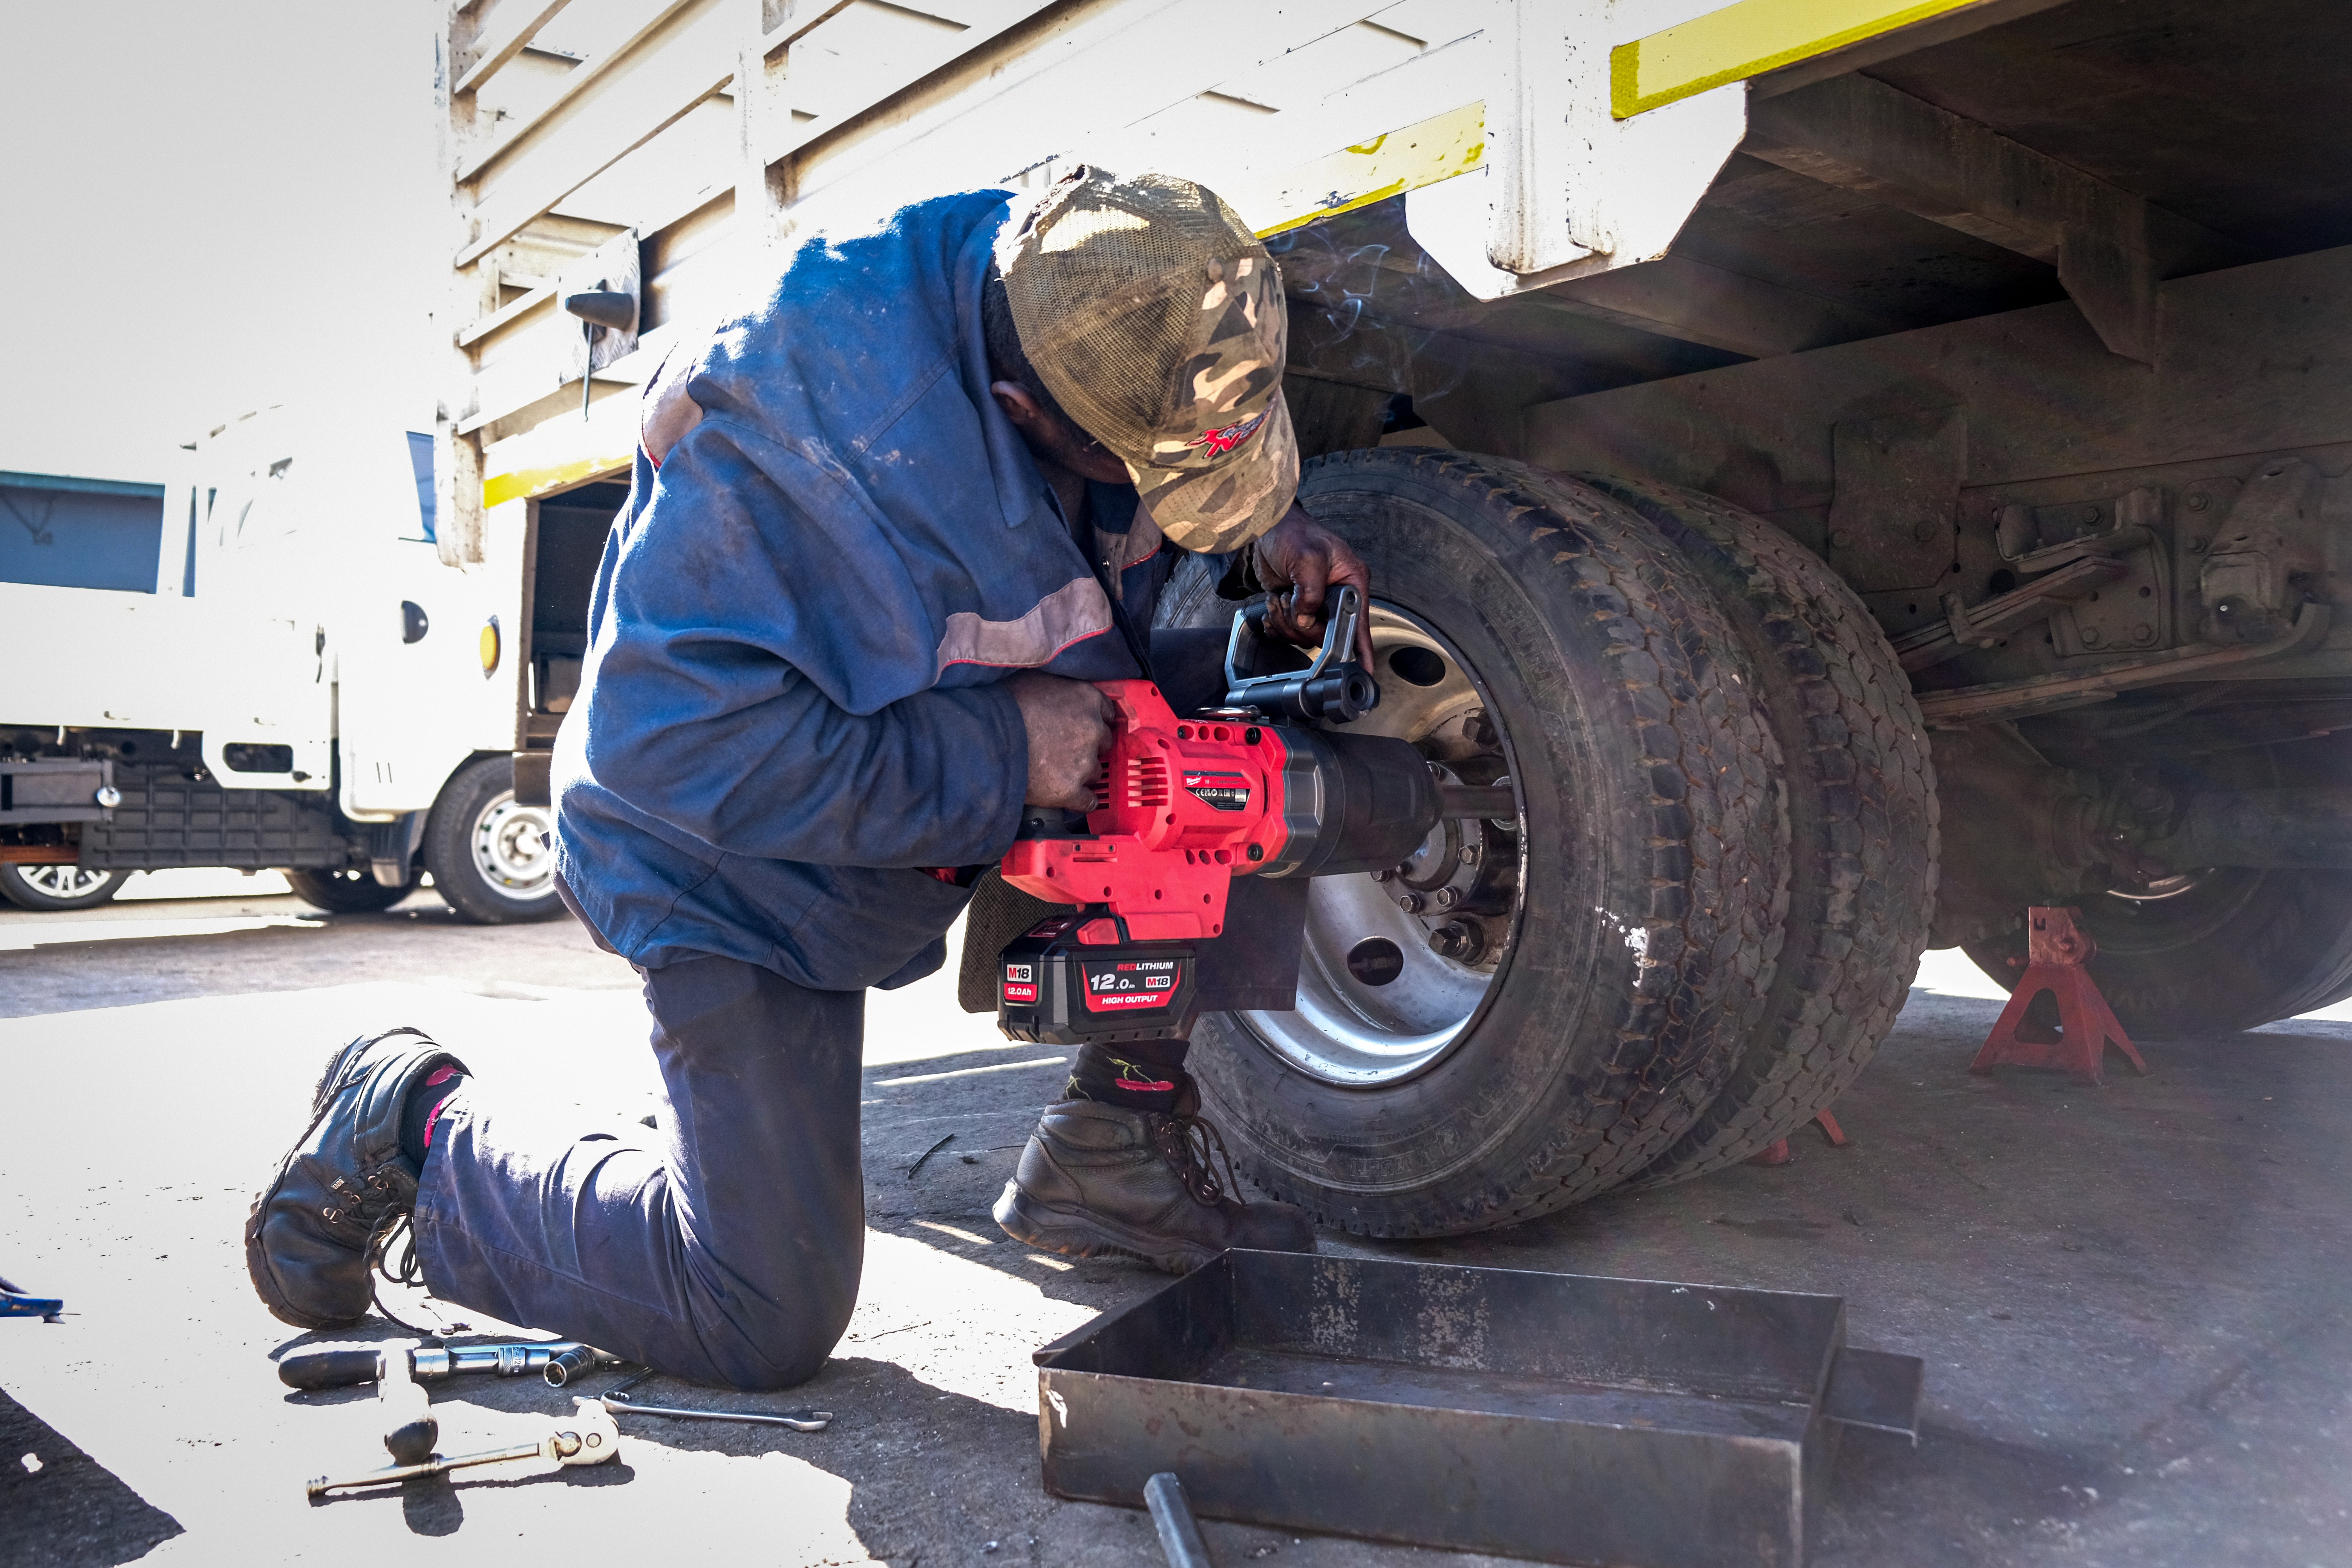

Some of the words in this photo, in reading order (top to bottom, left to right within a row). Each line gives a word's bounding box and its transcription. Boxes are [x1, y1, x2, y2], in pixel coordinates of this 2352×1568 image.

[1117, 962, 1174, 971] REDLITHIUM
[1008, 967, 1030, 979] M18
[1147, 977, 1169, 986] M18
[1008, 987, 1032, 996] 12.0Ah
[1102, 996, 1124, 1004] HIGH
[1125, 995, 1158, 1003] OUTPUT
[331, 1178, 345, 1190] BOVA
